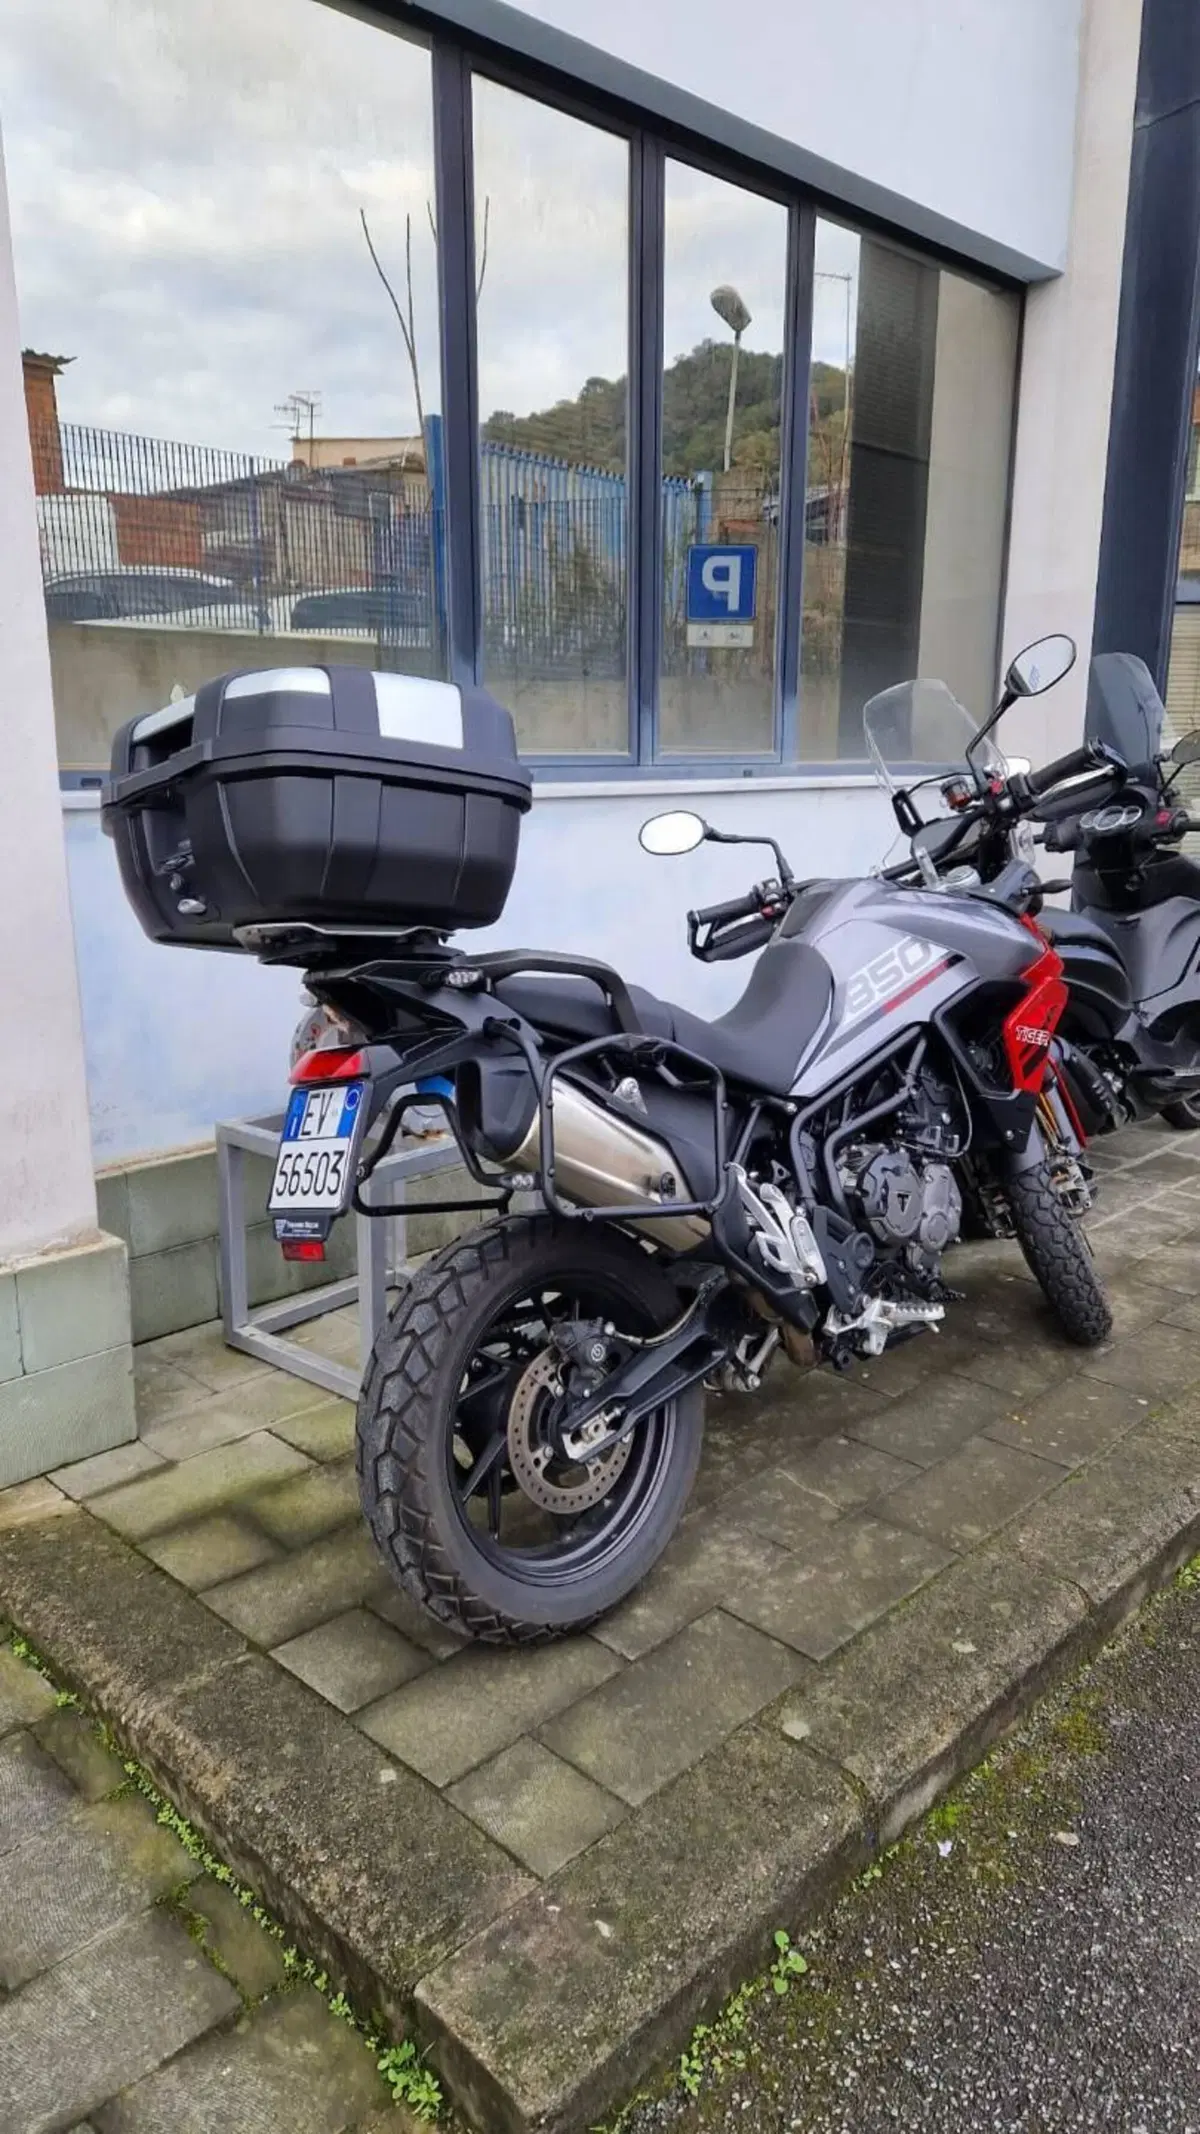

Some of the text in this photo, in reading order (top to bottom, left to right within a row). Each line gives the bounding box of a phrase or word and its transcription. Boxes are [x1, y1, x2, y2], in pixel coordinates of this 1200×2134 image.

[846, 938, 932, 1014] 850
[1016, 1025, 1050, 1046] TIGER
[301, 1091, 333, 1135] EV
[276, 1150, 345, 1196] 56503
